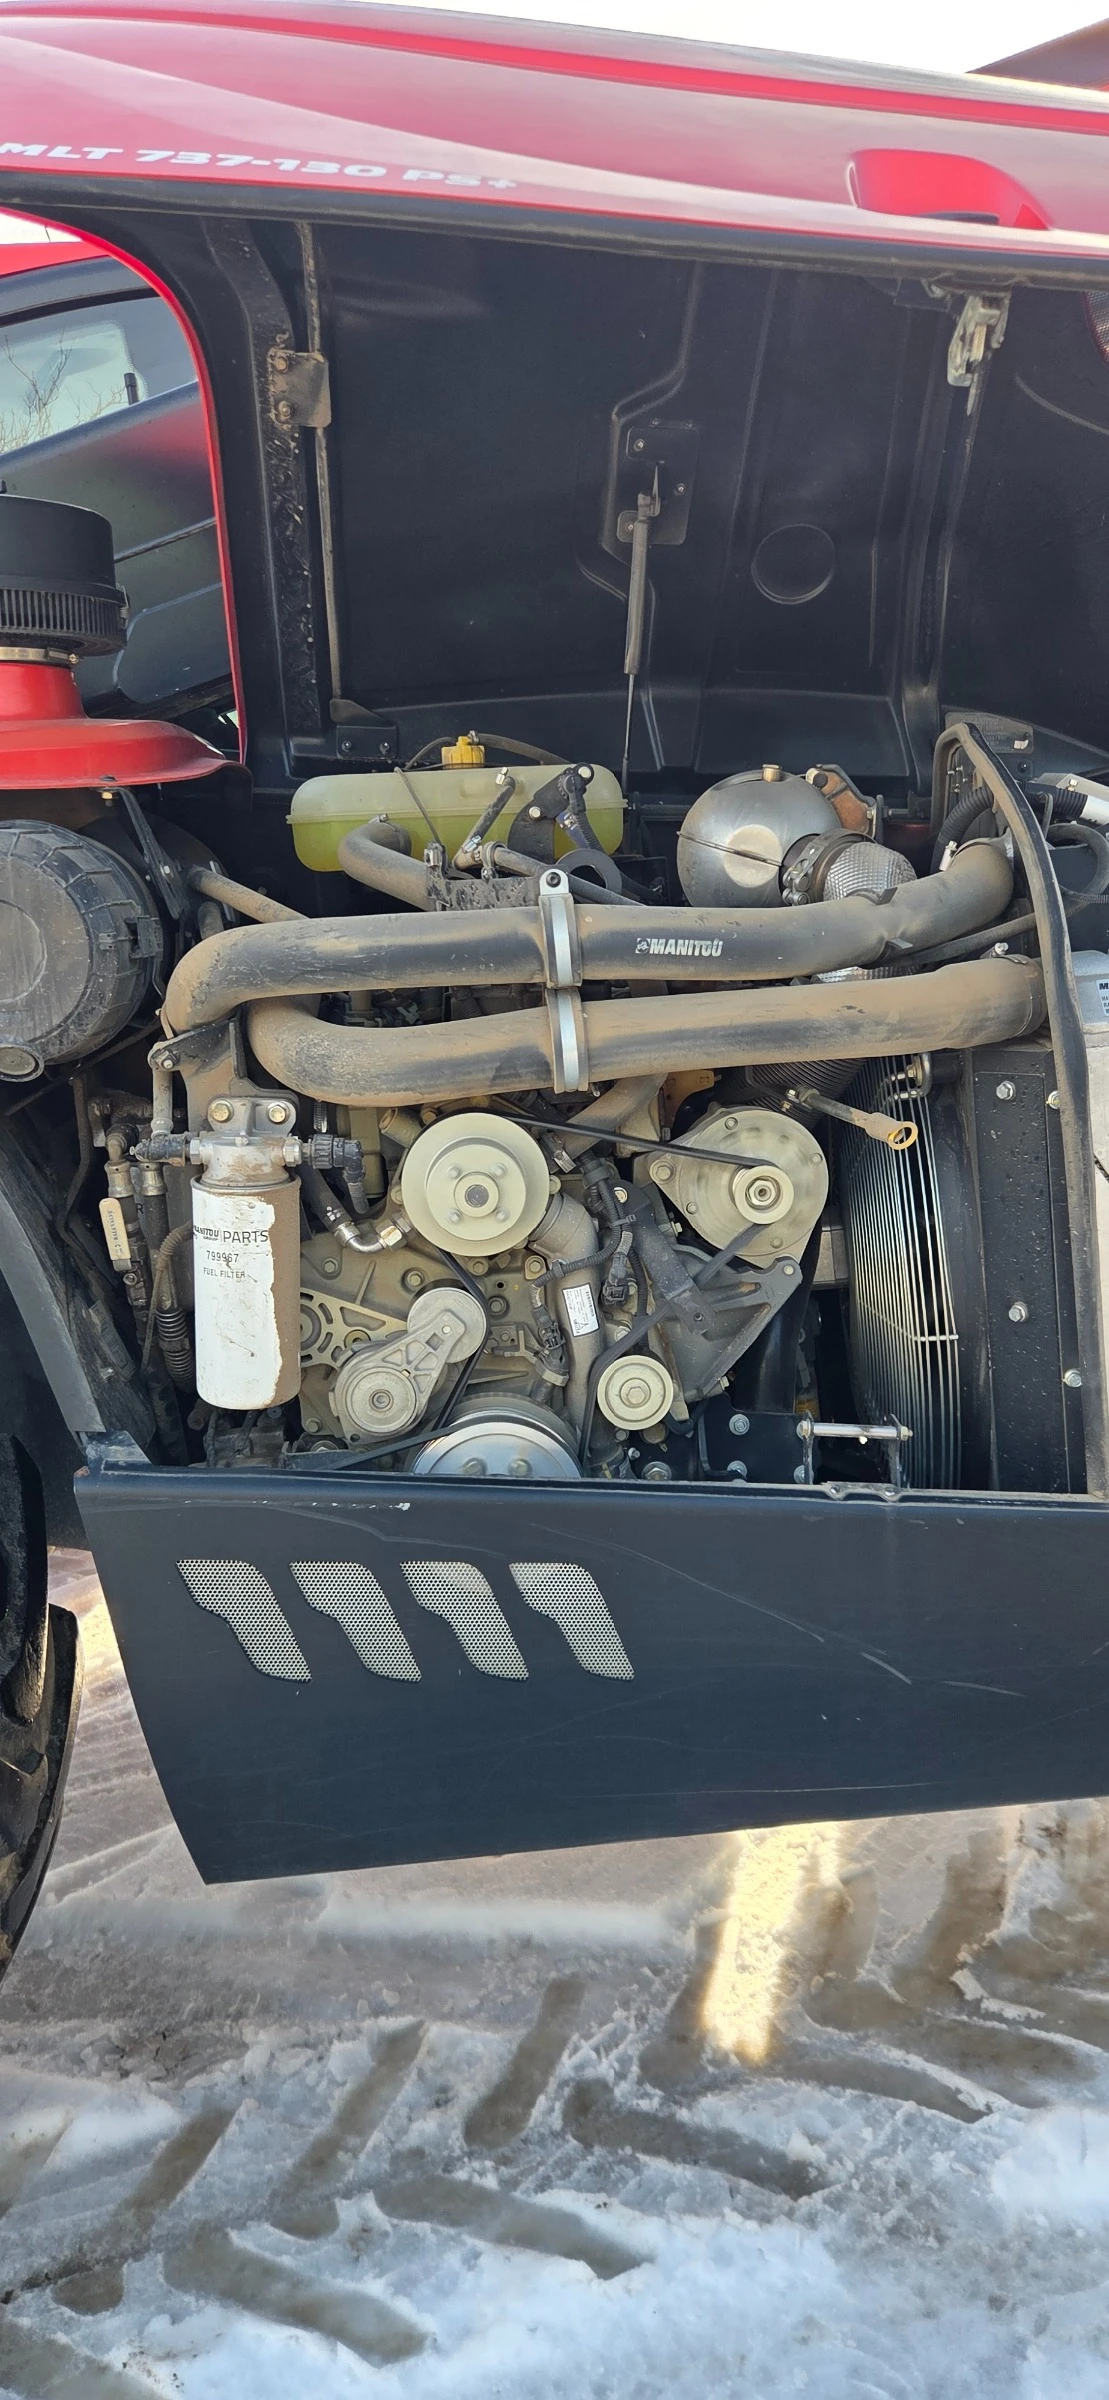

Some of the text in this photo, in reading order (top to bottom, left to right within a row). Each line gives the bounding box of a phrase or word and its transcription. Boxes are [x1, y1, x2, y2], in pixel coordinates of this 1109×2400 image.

[0, 142, 517, 189] MLT 737-130 PS+
[648, 938, 724, 957] MANITOU
[222, 1230, 269, 1244] PARTS
[206, 1249, 240, 1263] 799967
[203, 1266, 246, 1279] FUEL FILTER
